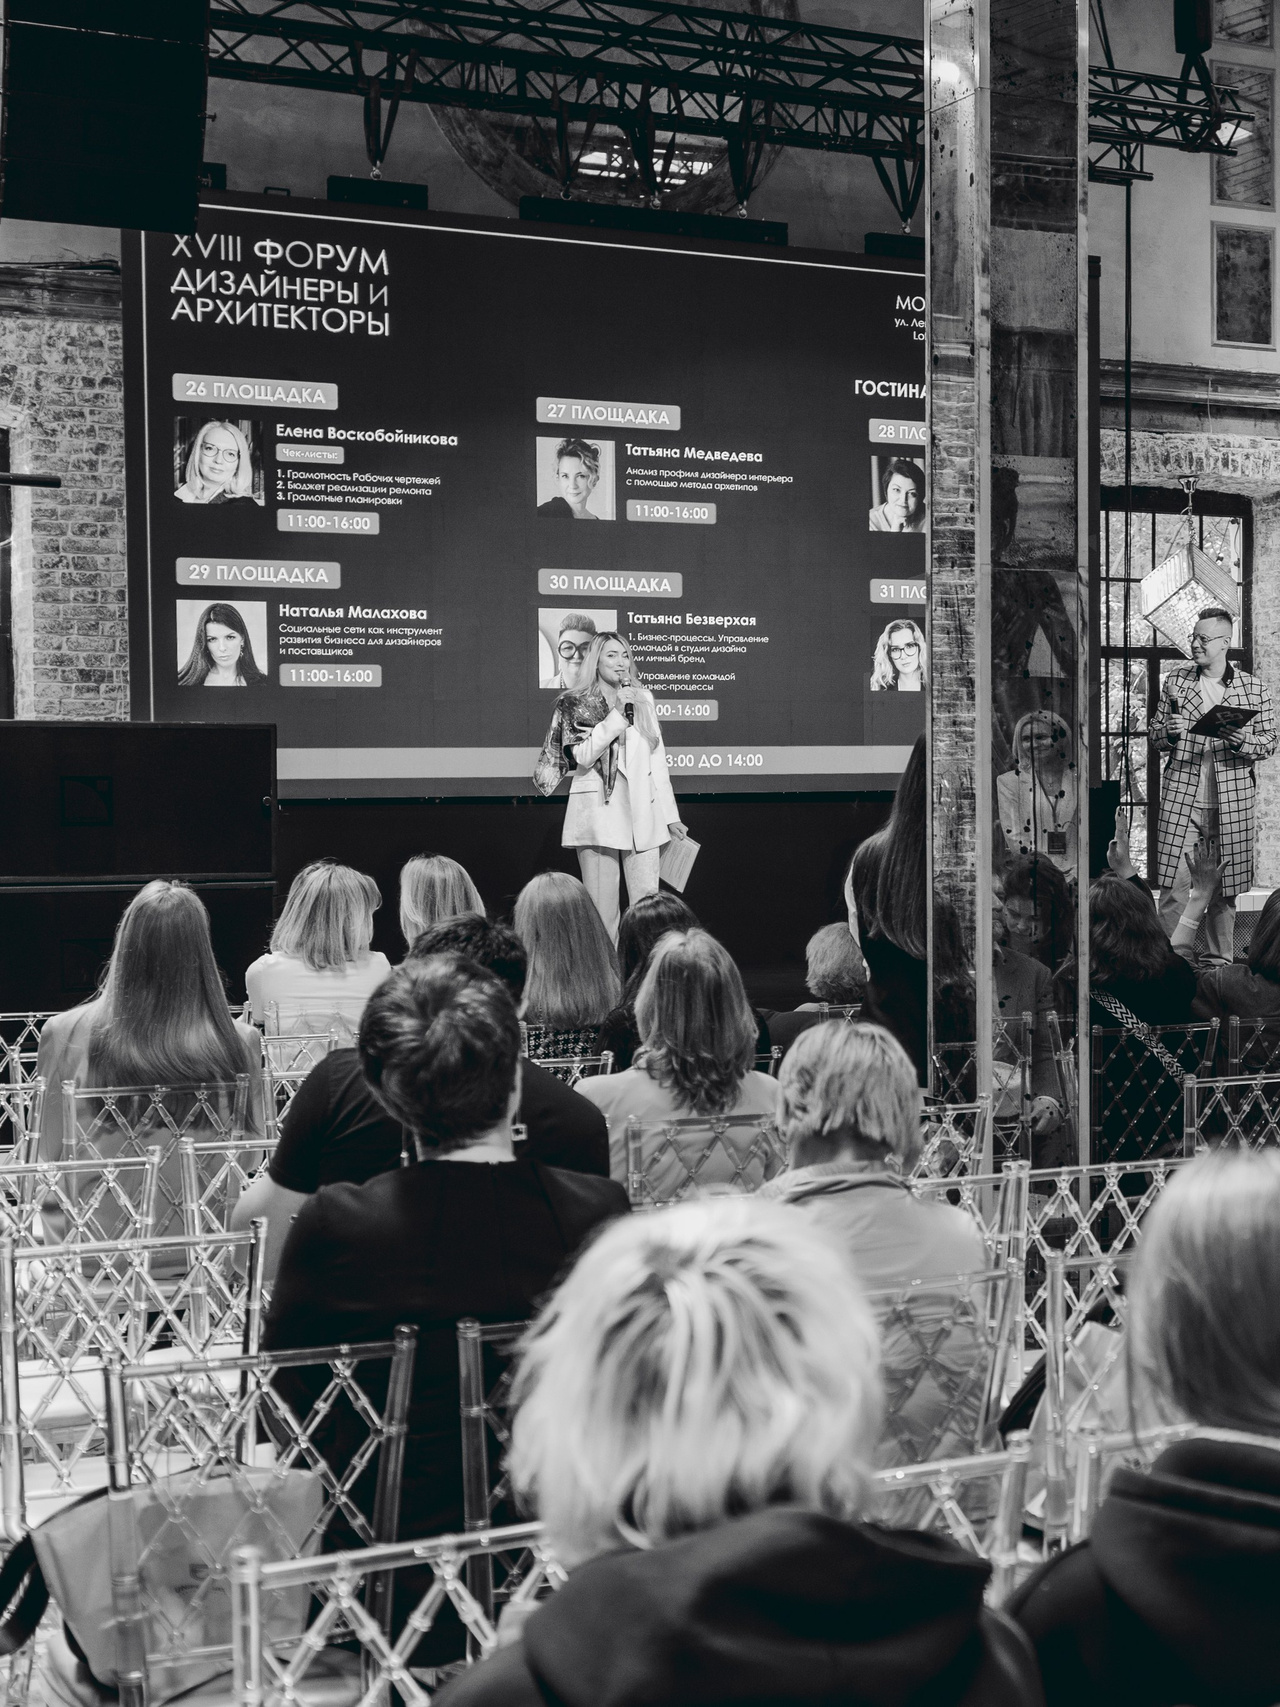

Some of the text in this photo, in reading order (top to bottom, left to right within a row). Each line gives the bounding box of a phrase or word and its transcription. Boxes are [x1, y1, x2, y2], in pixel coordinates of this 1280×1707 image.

[171, 232, 389, 276] XVIII ФОРУМ
[170, 267, 388, 307] ДИЗАЙНЕРЫ И
[170, 296, 389, 337] АРХИТЕКТОРЫ
[894, 318, 927, 328] ул. Ле
[913, 331, 927, 341] Lo
[185, 380, 326, 404] 26 ПЛОЩАДКА
[547, 403, 670, 425] 27 ПЛОЩАДКА
[276, 423, 458, 446] Елена Воскобойникова
[878, 424, 895, 438] 28
[282, 448, 338, 459] Чек-листы:
[625, 443, 763, 463] Татьяна Медведева
[276, 469, 441, 485] 1. Грамотность Рабочих чертежей
[625, 467, 793, 484] Анализ профиля дизайнера интерьера
[276, 481, 432, 496] 2. Бюджет реализации ремонта
[634, 479, 678, 488] помощью
[679, 482, 713, 490] метода
[714, 483, 758, 492] архетипов
[276, 492, 402, 506] 3. Грамотные планировки
[635, 504, 709, 520] 11:00-16:00
[288, 515, 370, 529] 11:00-16:00
[189, 564, 329, 584] 29 ПЛОЩАДКА
[549, 575, 672, 593] 30 ПЛОЩАДКА
[880, 584, 894, 598] 31
[279, 604, 427, 620] Наталья Малахова
[627, 612, 756, 628] Татьяна Безверхая
[279, 623, 442, 636] Социальные сети как инструмент
[279, 636, 442, 647] развития бизнеса для дизайнеров
[628, 633, 769, 644] 1. Бизнес-процессы. Управление
[288, 647, 353, 656] поставщиков
[681, 645, 710, 654] студии
[711, 644, 747, 653] дизайна
[646, 654, 676, 662] личный
[678, 655, 705, 664] бренд
[290, 669, 373, 683] 11:00-16:00
[637, 672, 736, 681] Управление командой
[643, 683, 714, 692] изнес-процессы
[656, 704, 710, 716] 00-16:00
[666, 754, 763, 768] 3:00 ДО 14:00
